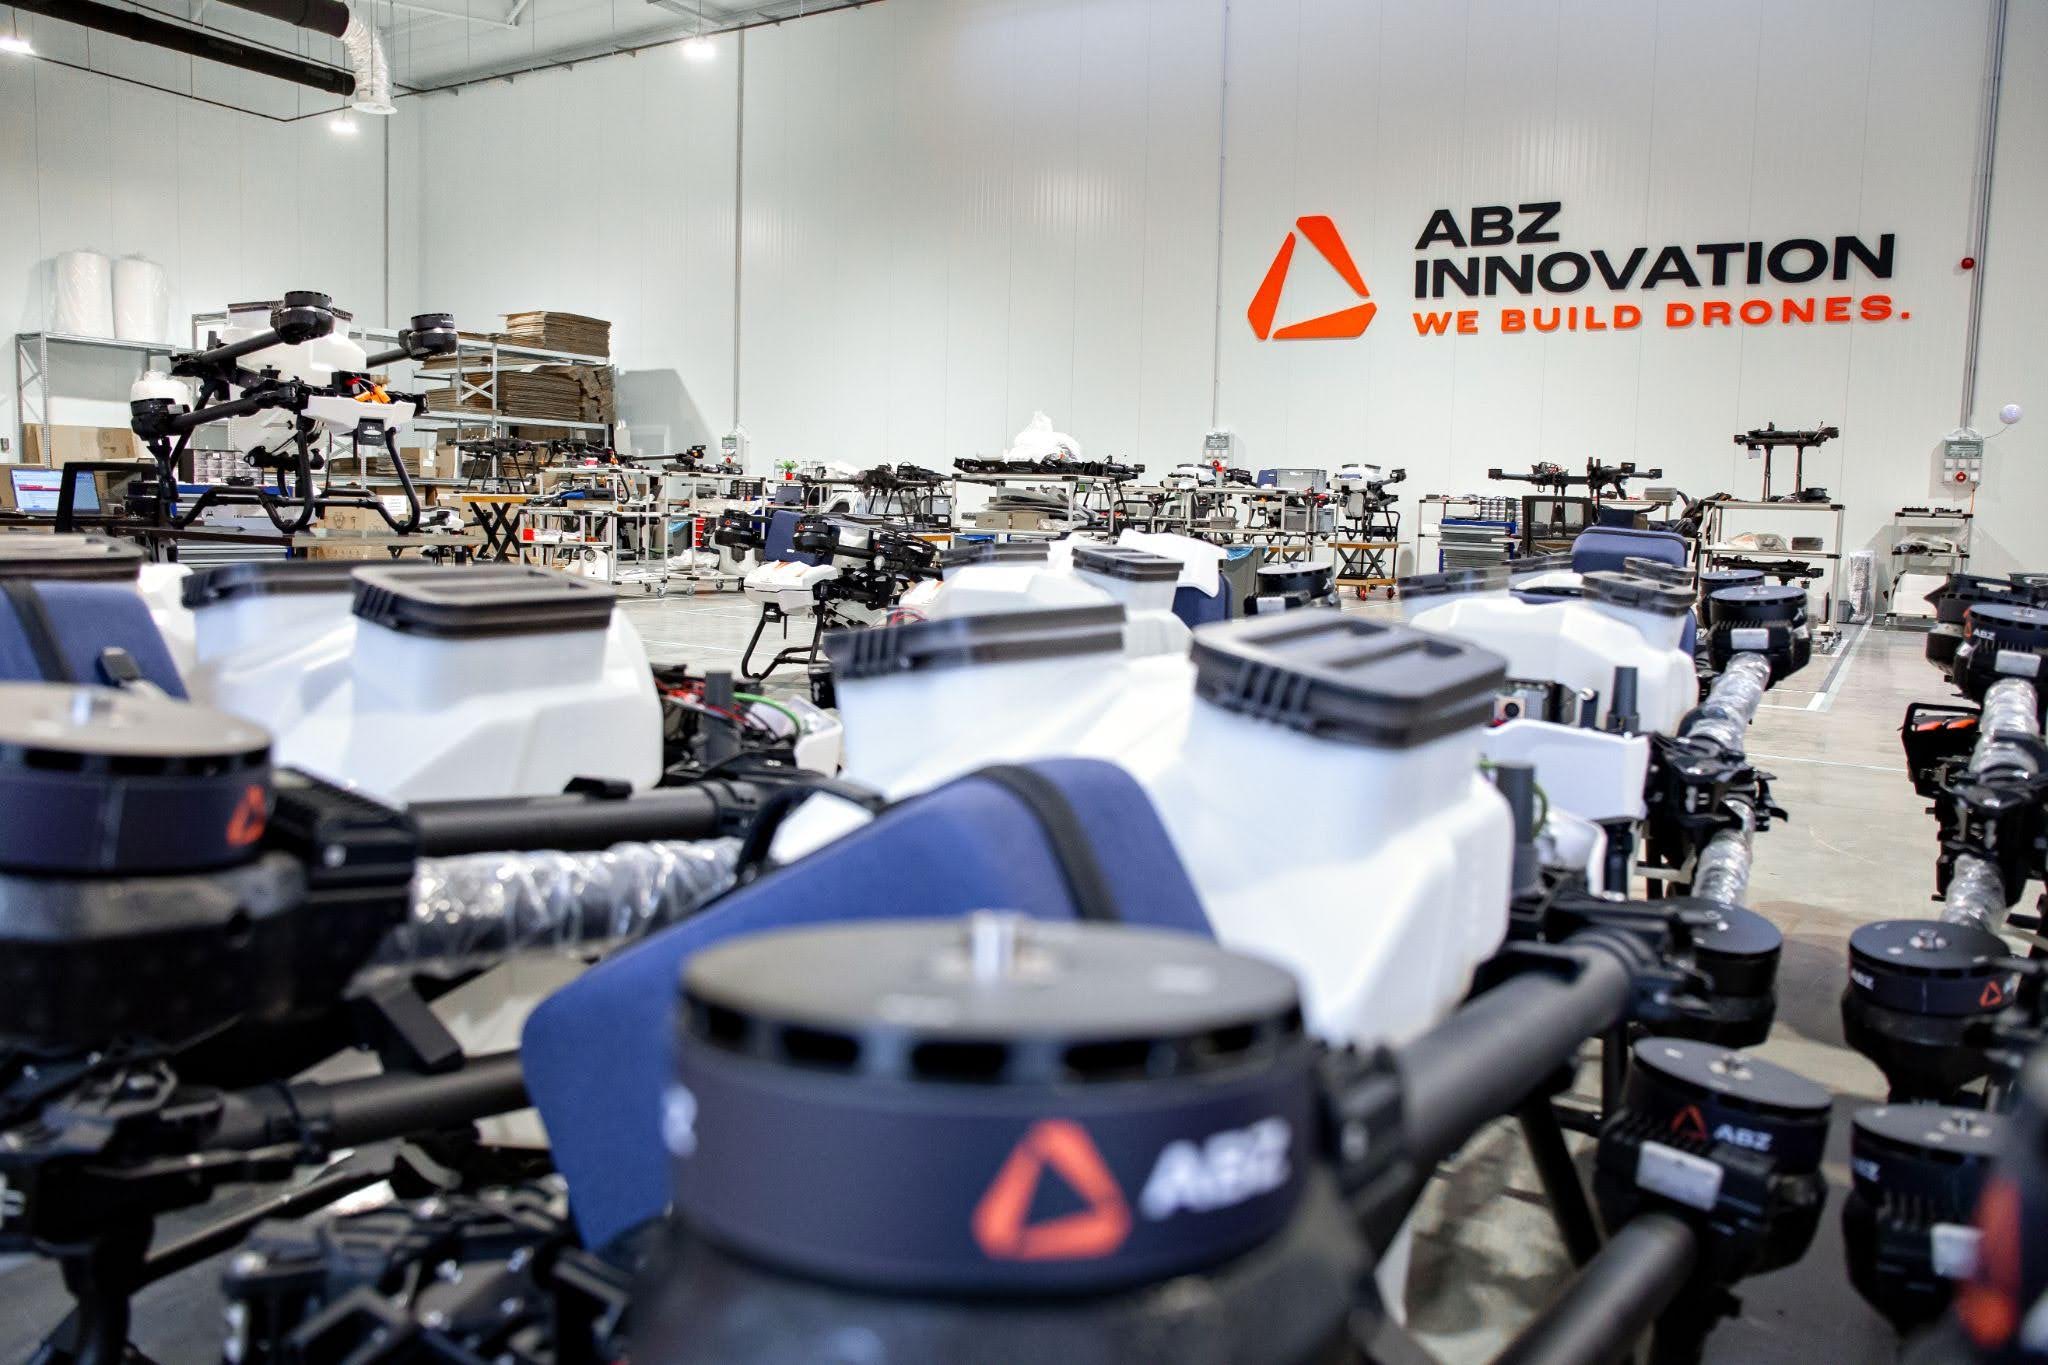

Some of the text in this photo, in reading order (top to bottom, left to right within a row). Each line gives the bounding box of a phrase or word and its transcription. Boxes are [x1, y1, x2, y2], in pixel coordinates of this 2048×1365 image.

[1414, 201, 1563, 250] ABZ
[1414, 233, 1896, 299] INNOVATION
[1412, 294, 1911, 335] WE BUILD DRONES.
[1972, 627, 1997, 641] ABZ
[1713, 1123, 1773, 1152] ABZ
[1138, 1115, 1292, 1221] ABZ
